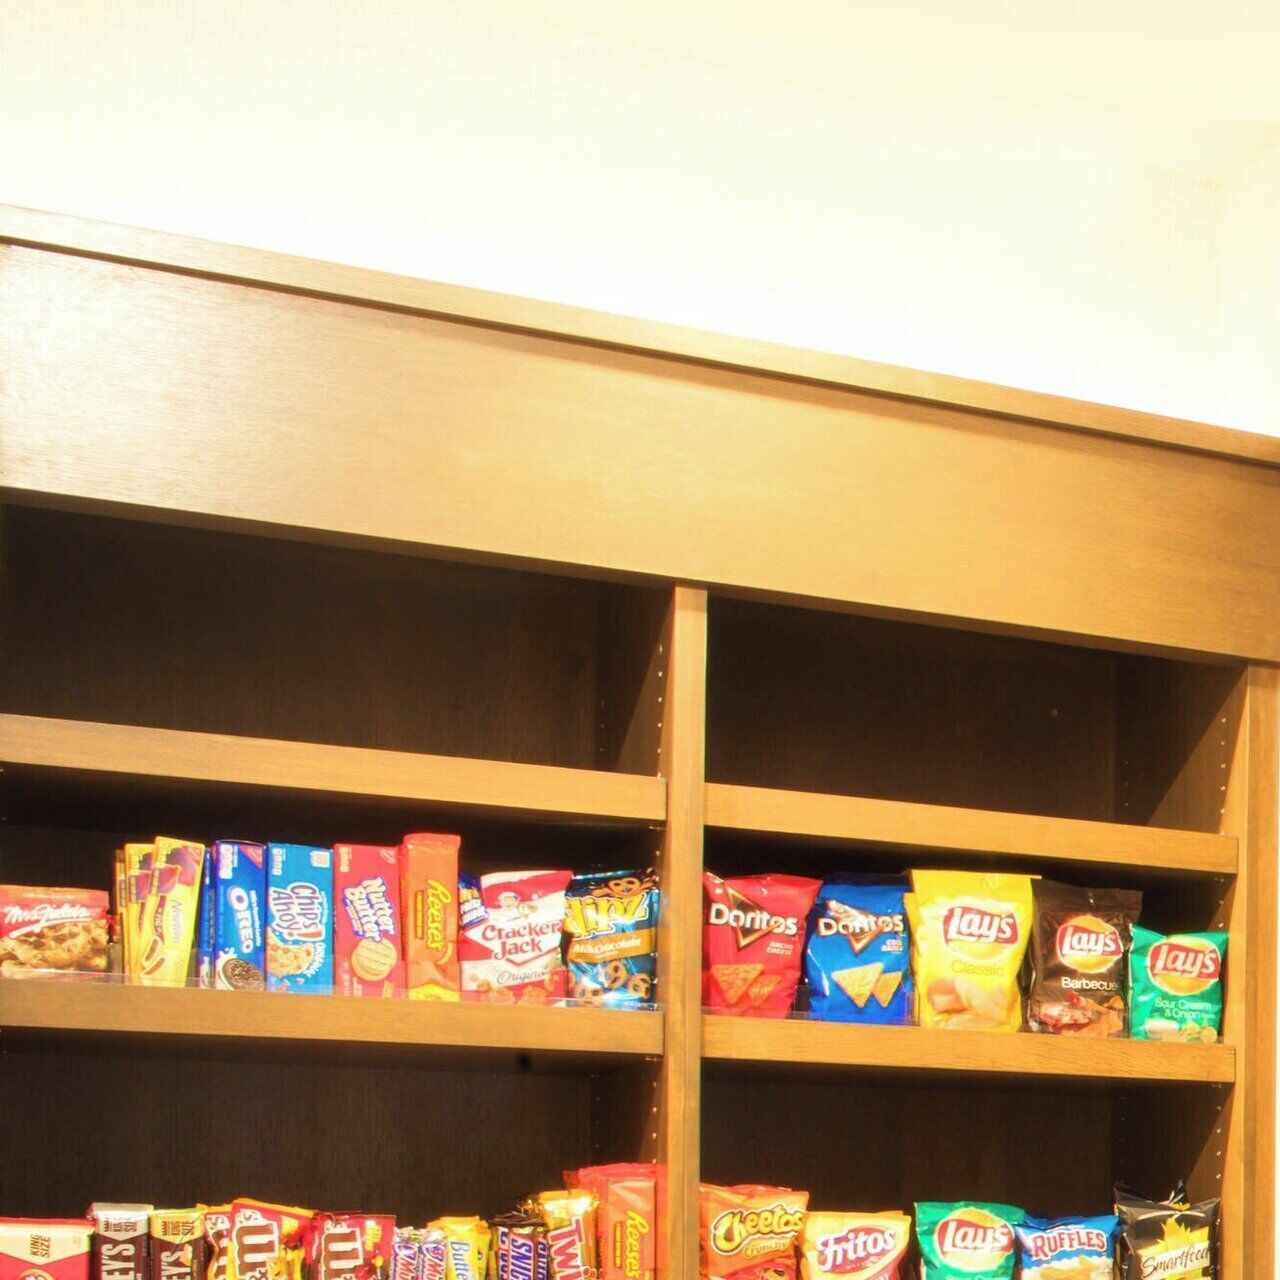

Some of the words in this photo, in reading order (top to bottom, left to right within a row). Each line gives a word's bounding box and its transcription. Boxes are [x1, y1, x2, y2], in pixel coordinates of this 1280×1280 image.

[228, 887, 254, 953] OREO
[289, 884, 319, 934] Chips
[344, 887, 382, 942] Butter
[362, 878, 395, 935] Nutter
[709, 902, 799, 935] Doritos
[482, 921, 561, 941] Cracker
[818, 915, 904, 936] Doritos
[948, 906, 1014, 944] Lay's
[494, 937, 541, 960] Jack
[1062, 931, 1117, 955] Lay's
[951, 960, 1004, 978] Classic
[1153, 945, 1217, 976] Lay's
[1061, 977, 1118, 991] Barbecue
[30, 1234, 40, 1256] KING
[713, 1206, 804, 1254] Cheetos
[944, 1220, 1010, 1251] Lay's
[1031, 1230, 1106, 1260] RUFFLES
[41, 1235, 51, 1258] SIZE
[816, 1229, 896, 1272] Fritos
